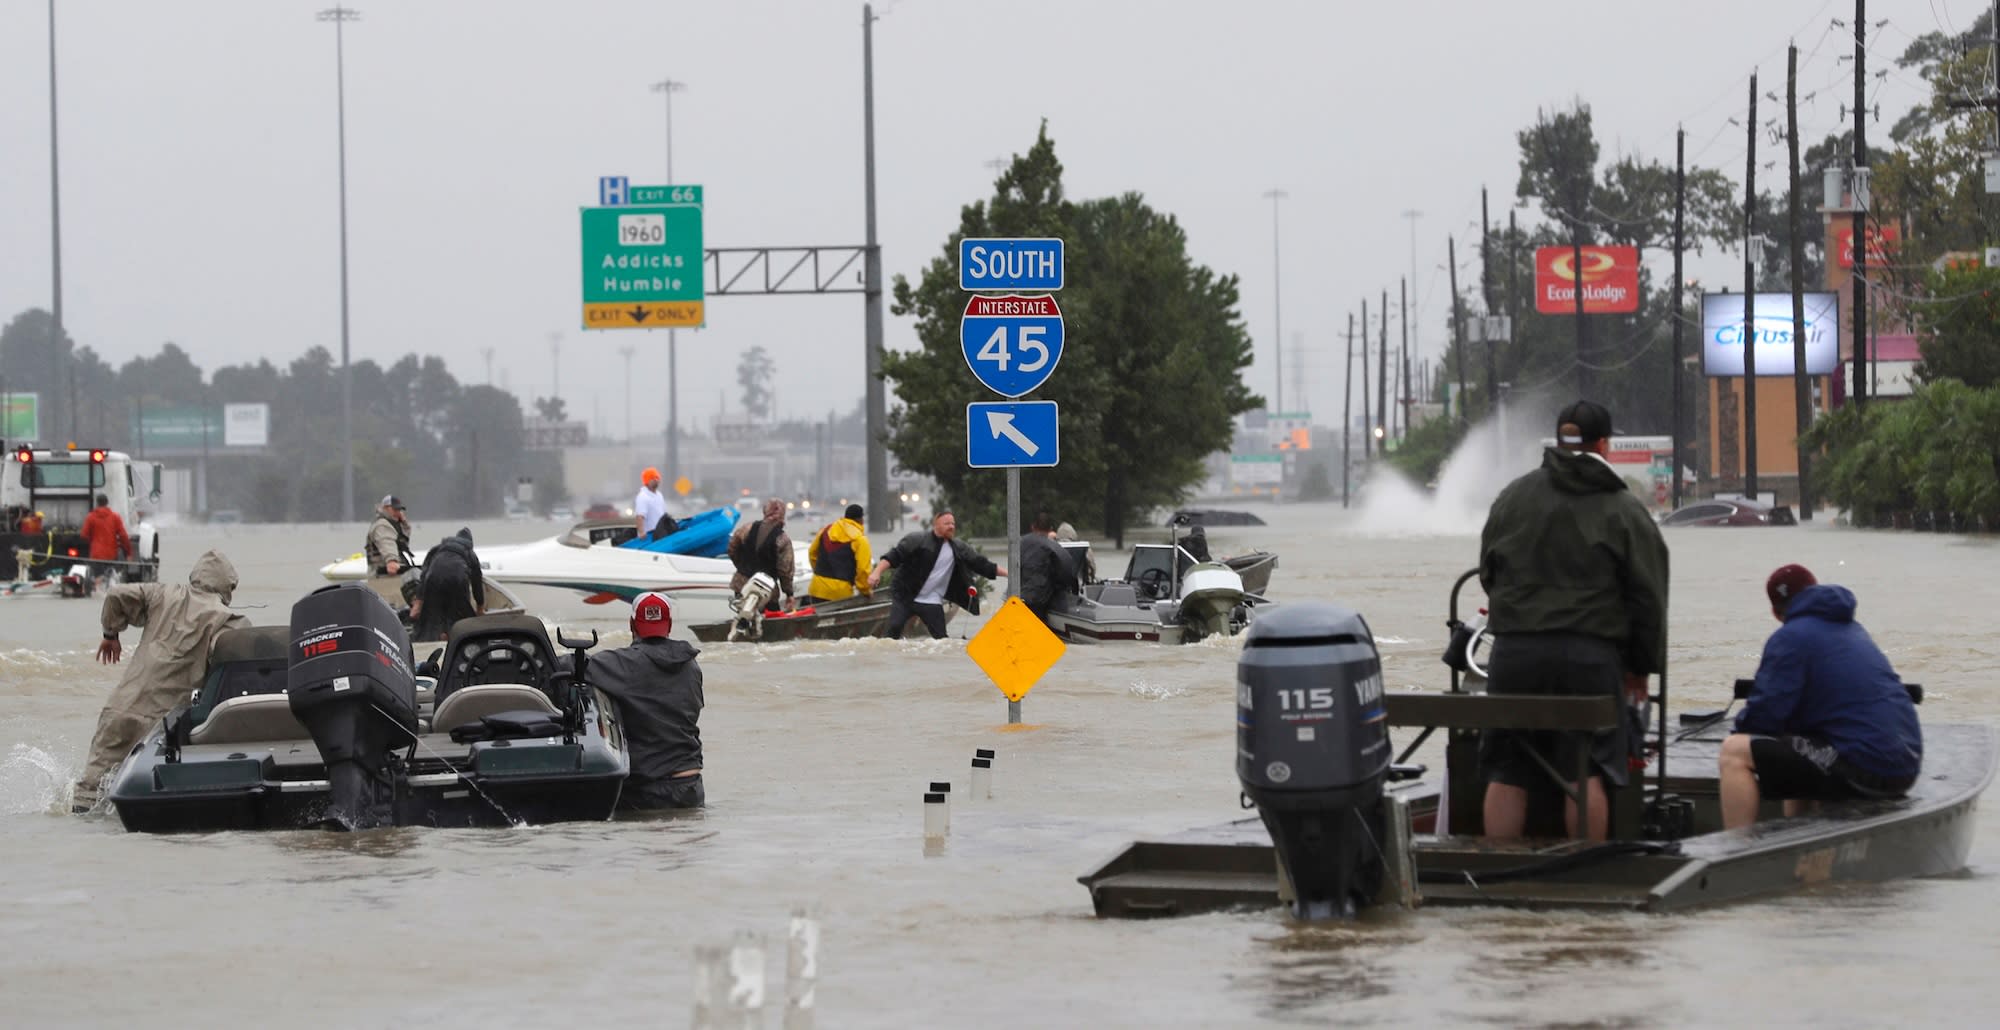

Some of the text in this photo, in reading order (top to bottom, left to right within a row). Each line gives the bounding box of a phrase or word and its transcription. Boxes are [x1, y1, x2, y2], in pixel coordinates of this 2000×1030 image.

[636, 188, 695, 201] EXIT 66
[621, 225, 664, 243] 1960
[603, 254, 684, 269] Addicks
[969, 246, 1055, 279] SOUTH
[605, 277, 682, 292] Humble
[589, 309, 696, 322] EXIT ONLY
[978, 300, 1048, 315] INTERSTATE
[976, 326, 1049, 372] 45
[299, 631, 343, 648] TRACKER
[303, 639, 338, 657] 115
[1277, 688, 1334, 711] 115
